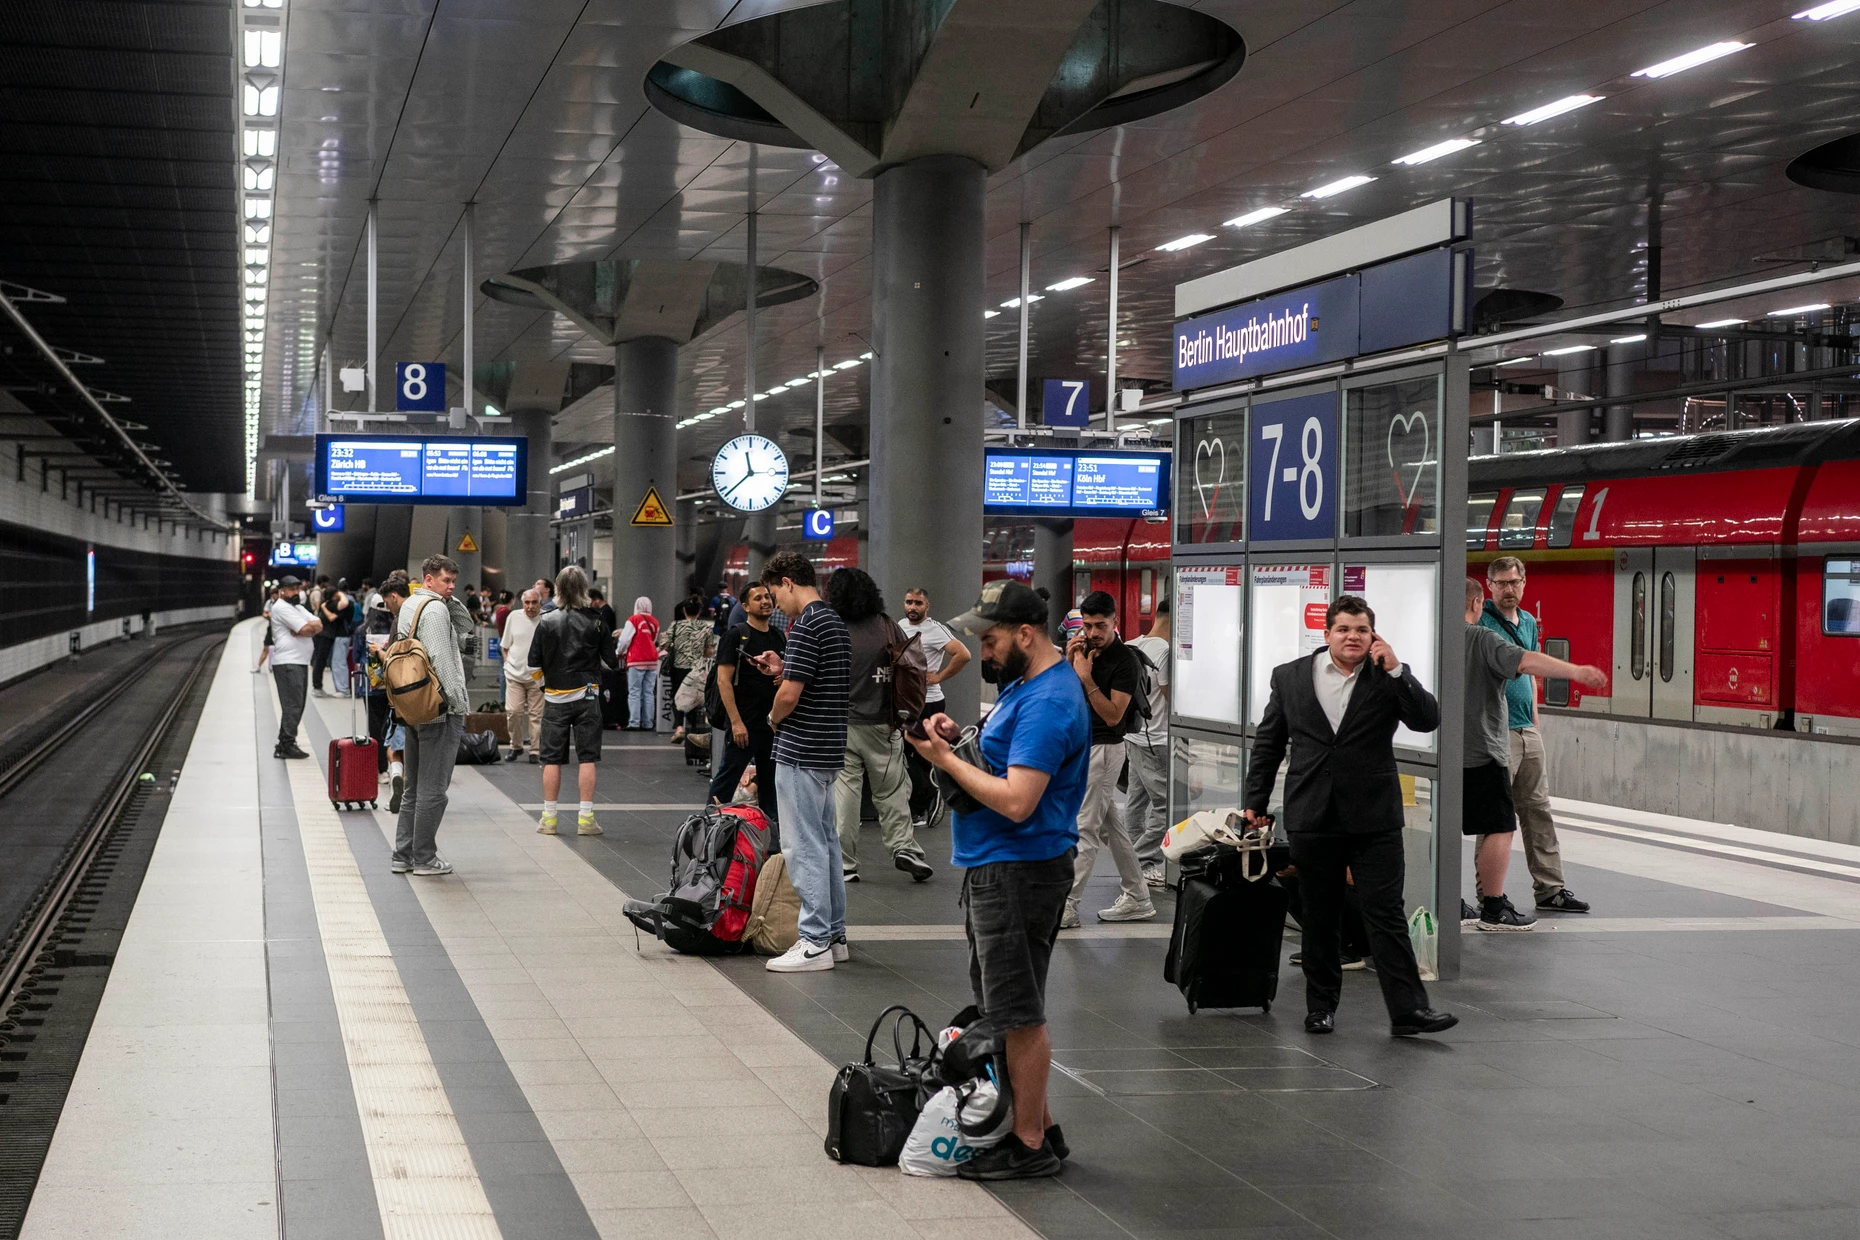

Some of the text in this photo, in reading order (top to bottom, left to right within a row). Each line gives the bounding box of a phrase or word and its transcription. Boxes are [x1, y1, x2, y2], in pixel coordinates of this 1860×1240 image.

[1178, 302, 1308, 369] Berlin Hauptbahnhof
[403, 364, 427, 400] 8
[1062, 381, 1084, 416] 7
[331, 448, 354, 458] 23:32
[331, 459, 353, 469] Zürich
[1077, 474, 1093, 482] Köln
[1093, 474, 1106, 483] Hbf
[1078, 464, 1098, 472] 23:51
[1262, 416, 1323, 521] 7-8
[315, 503, 335, 527] C
[812, 510, 831, 535] C
[1582, 487, 1610, 540] 1
[280, 543, 291, 557] B
[662, 680, 672, 721] Abfall
